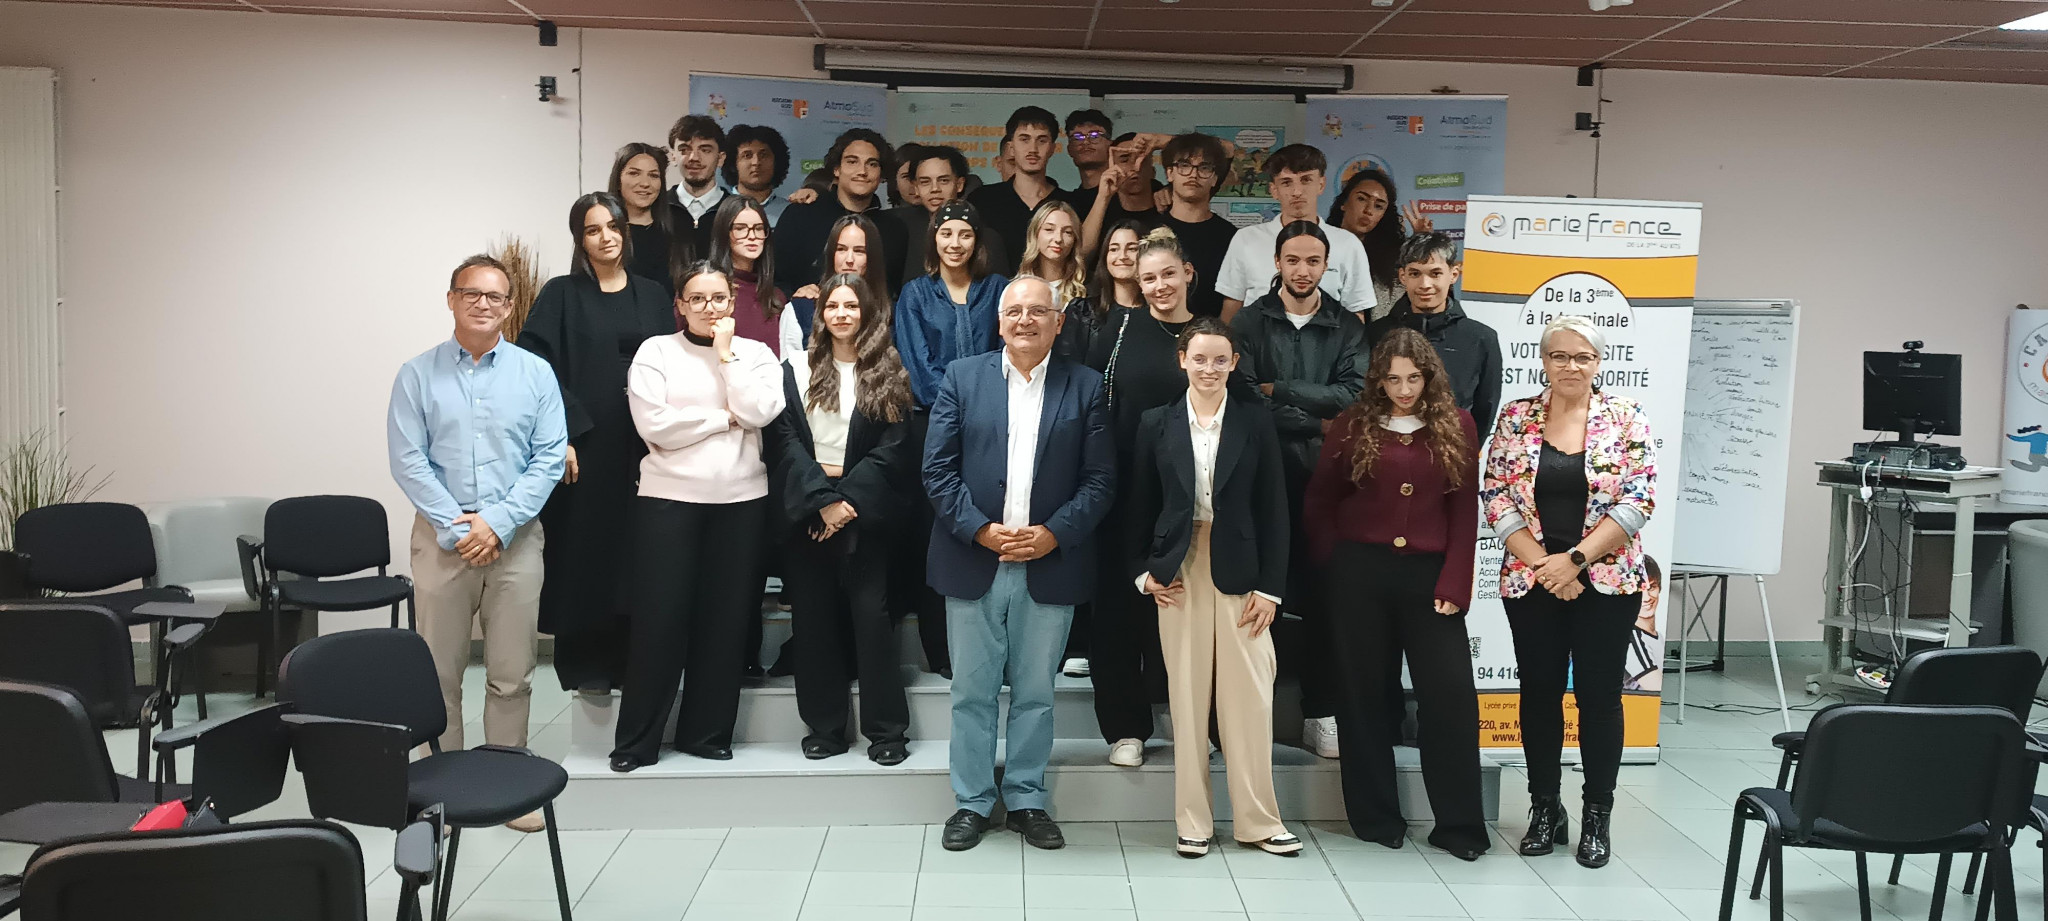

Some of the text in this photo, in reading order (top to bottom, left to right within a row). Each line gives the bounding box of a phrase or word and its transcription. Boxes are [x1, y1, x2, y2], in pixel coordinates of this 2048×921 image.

[1420, 202, 1441, 211] Prise
[1442, 202, 1454, 211] de
[1545, 287, 1614, 303] De la 3ème
[1526, 309, 1535, 325] à
[1540, 310, 1553, 326] la
[1510, 342, 1543, 359] VOT
[1502, 367, 1524, 384] ST
[1479, 555, 1503, 565] Vente
[1478, 567, 1502, 577] Accu
[1477, 666, 1493, 680] 94
[1499, 722, 1512, 730] av.
[1492, 732, 1523, 744] www.l
